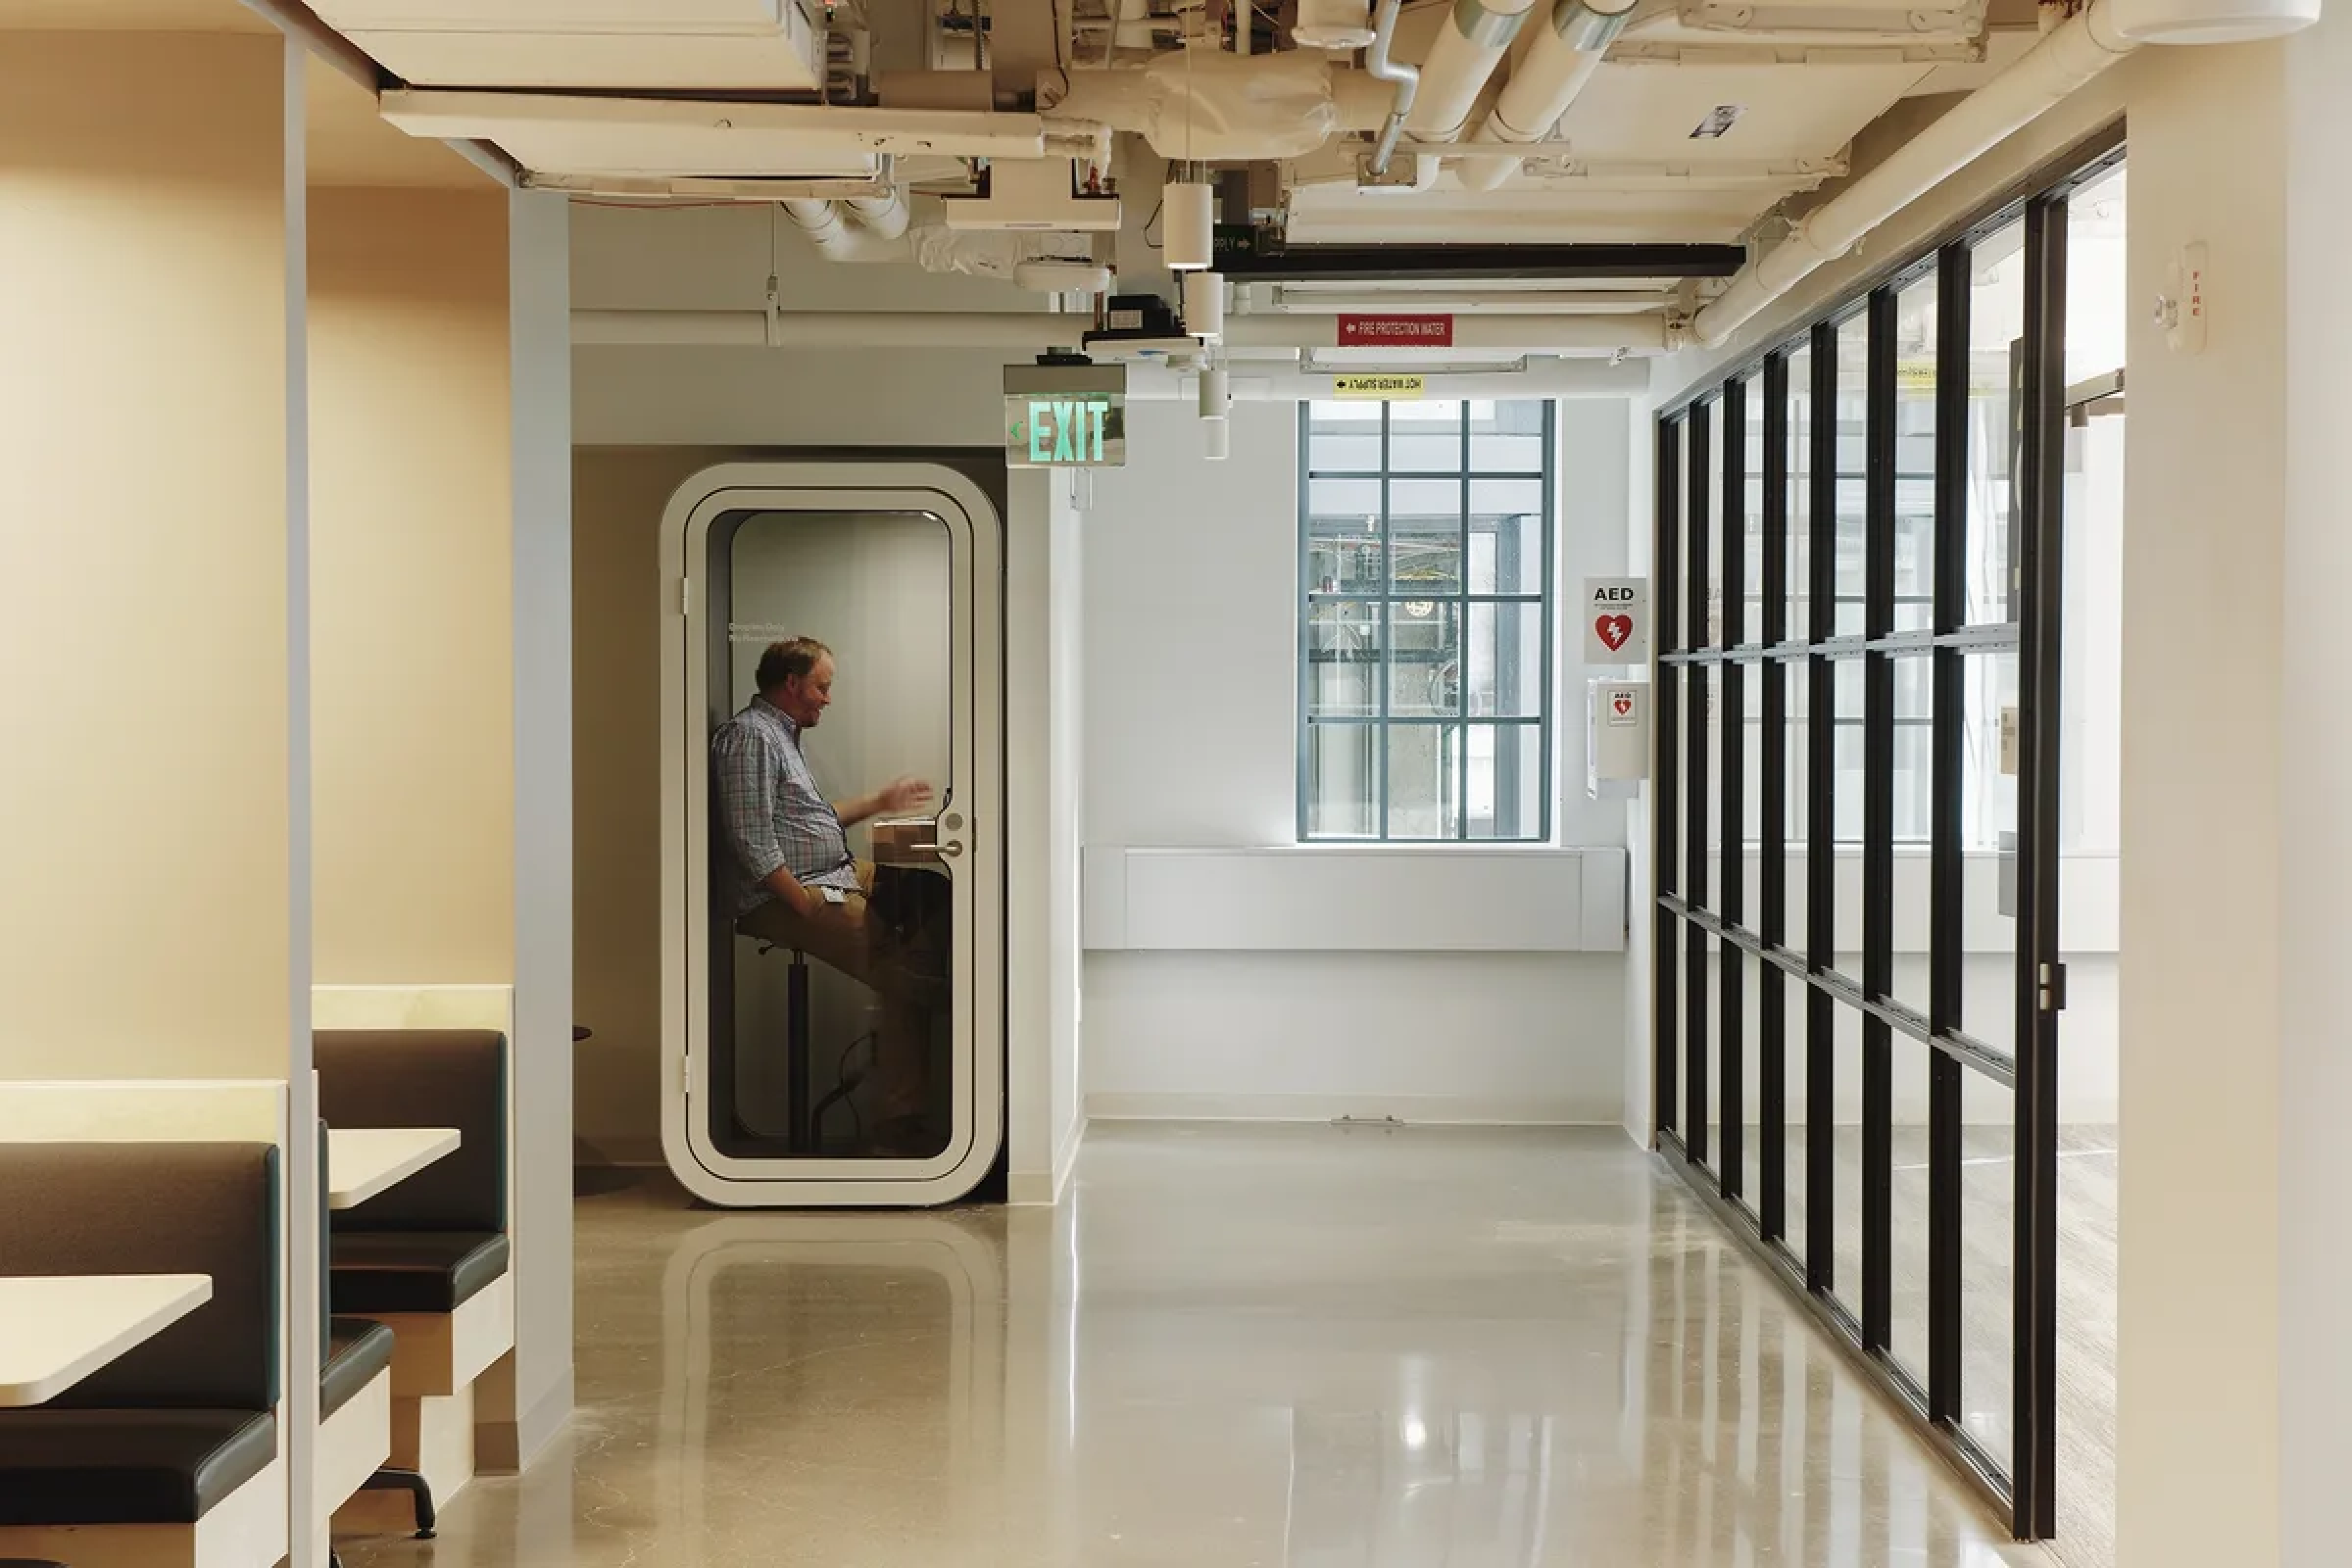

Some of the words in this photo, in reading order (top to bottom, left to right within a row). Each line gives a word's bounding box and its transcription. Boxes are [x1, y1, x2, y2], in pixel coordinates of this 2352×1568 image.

[1358, 321, 1374, 336] FIRE
[1376, 321, 1420, 336] PROTECTION
[1421, 321, 1445, 336] WATER
[1029, 401, 1108, 462] EXIT
[1594, 588, 1634, 600] AED
